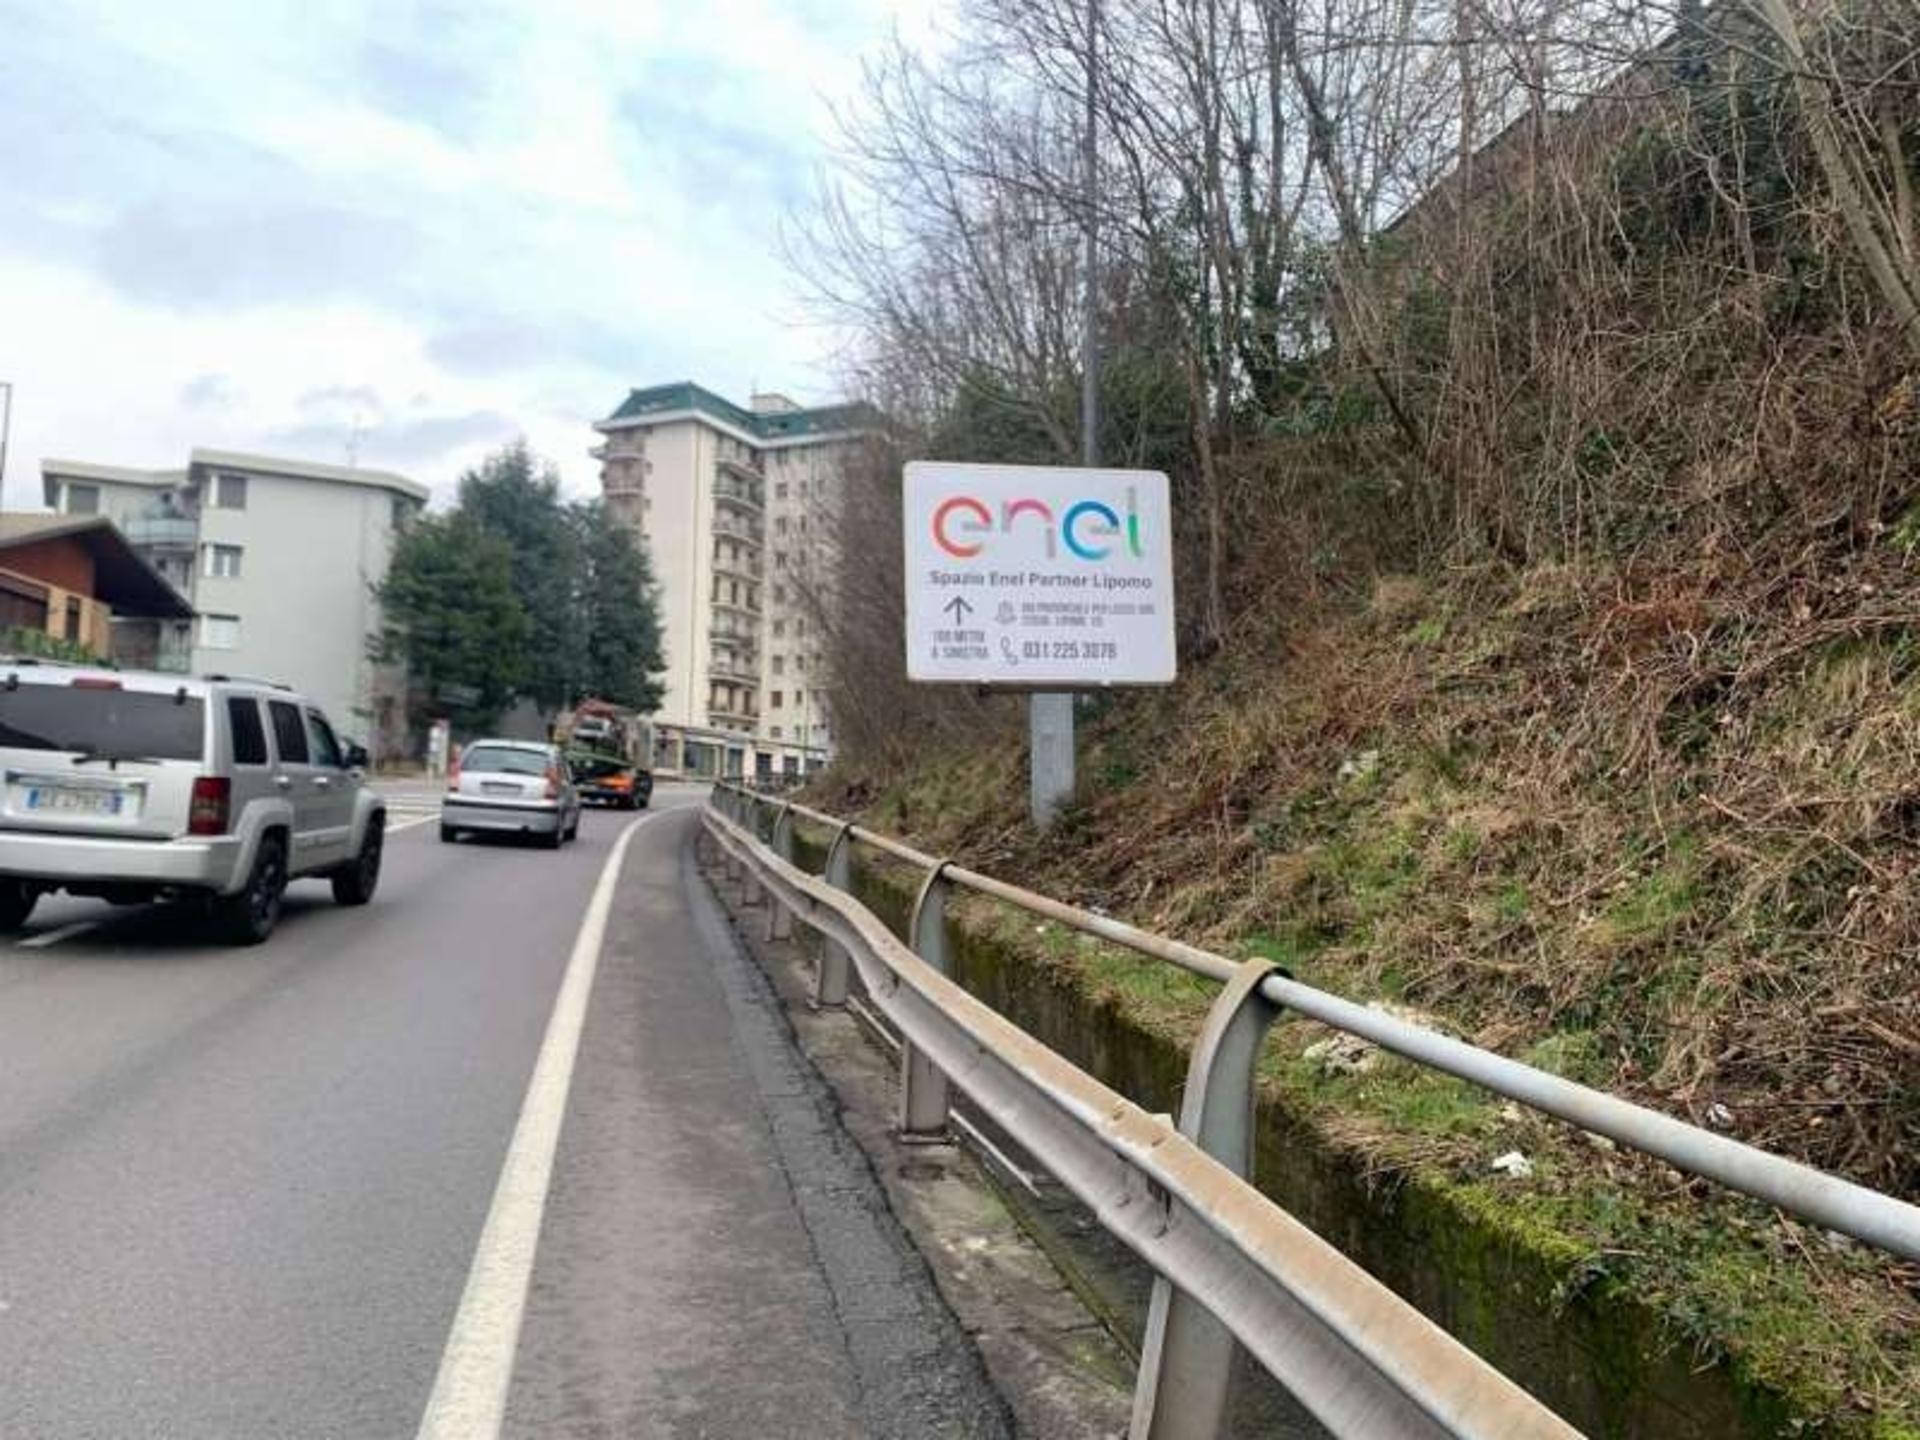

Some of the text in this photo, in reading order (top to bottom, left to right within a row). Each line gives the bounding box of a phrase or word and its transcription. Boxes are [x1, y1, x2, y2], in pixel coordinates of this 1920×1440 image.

[932, 486, 1142, 561] enel
[930, 571, 1153, 589] Spazio Enel Partner Lipomo
[1023, 640, 1047, 659] 031
[1053, 641, 1078, 659] 225
